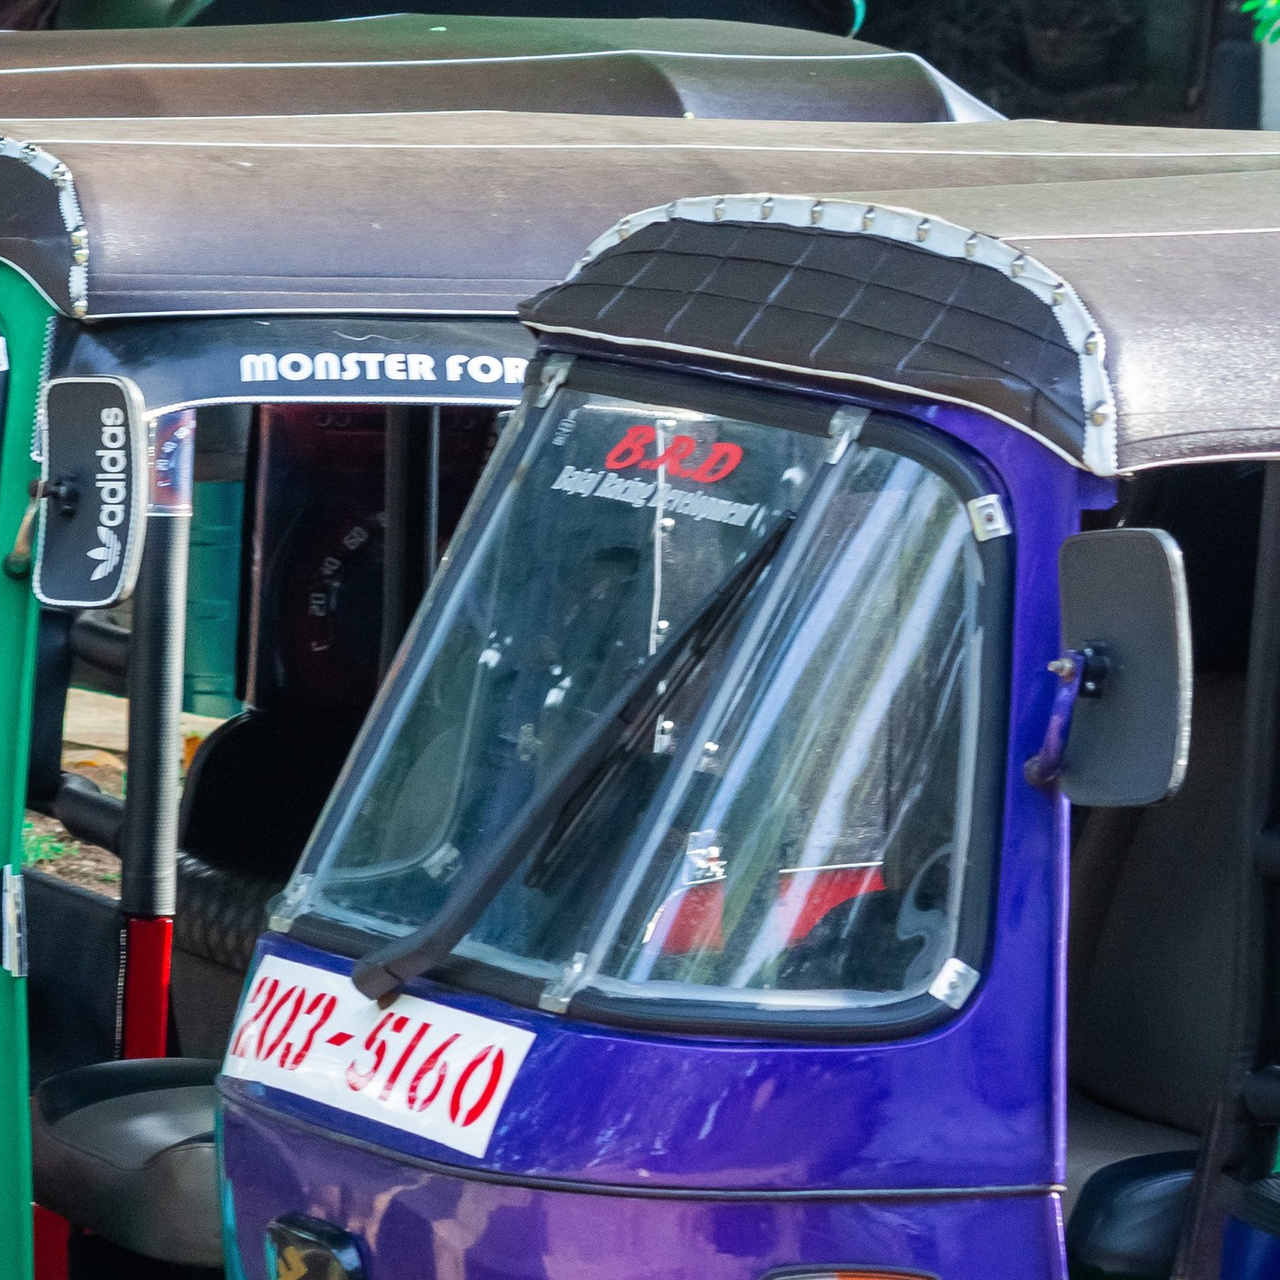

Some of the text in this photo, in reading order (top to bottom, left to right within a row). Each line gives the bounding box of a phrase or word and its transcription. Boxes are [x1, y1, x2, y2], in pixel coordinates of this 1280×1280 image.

[239, 352, 437, 382] MONSTER
[94, 407, 128, 527] adidas
[231, 976, 505, 1128] 203-5160
